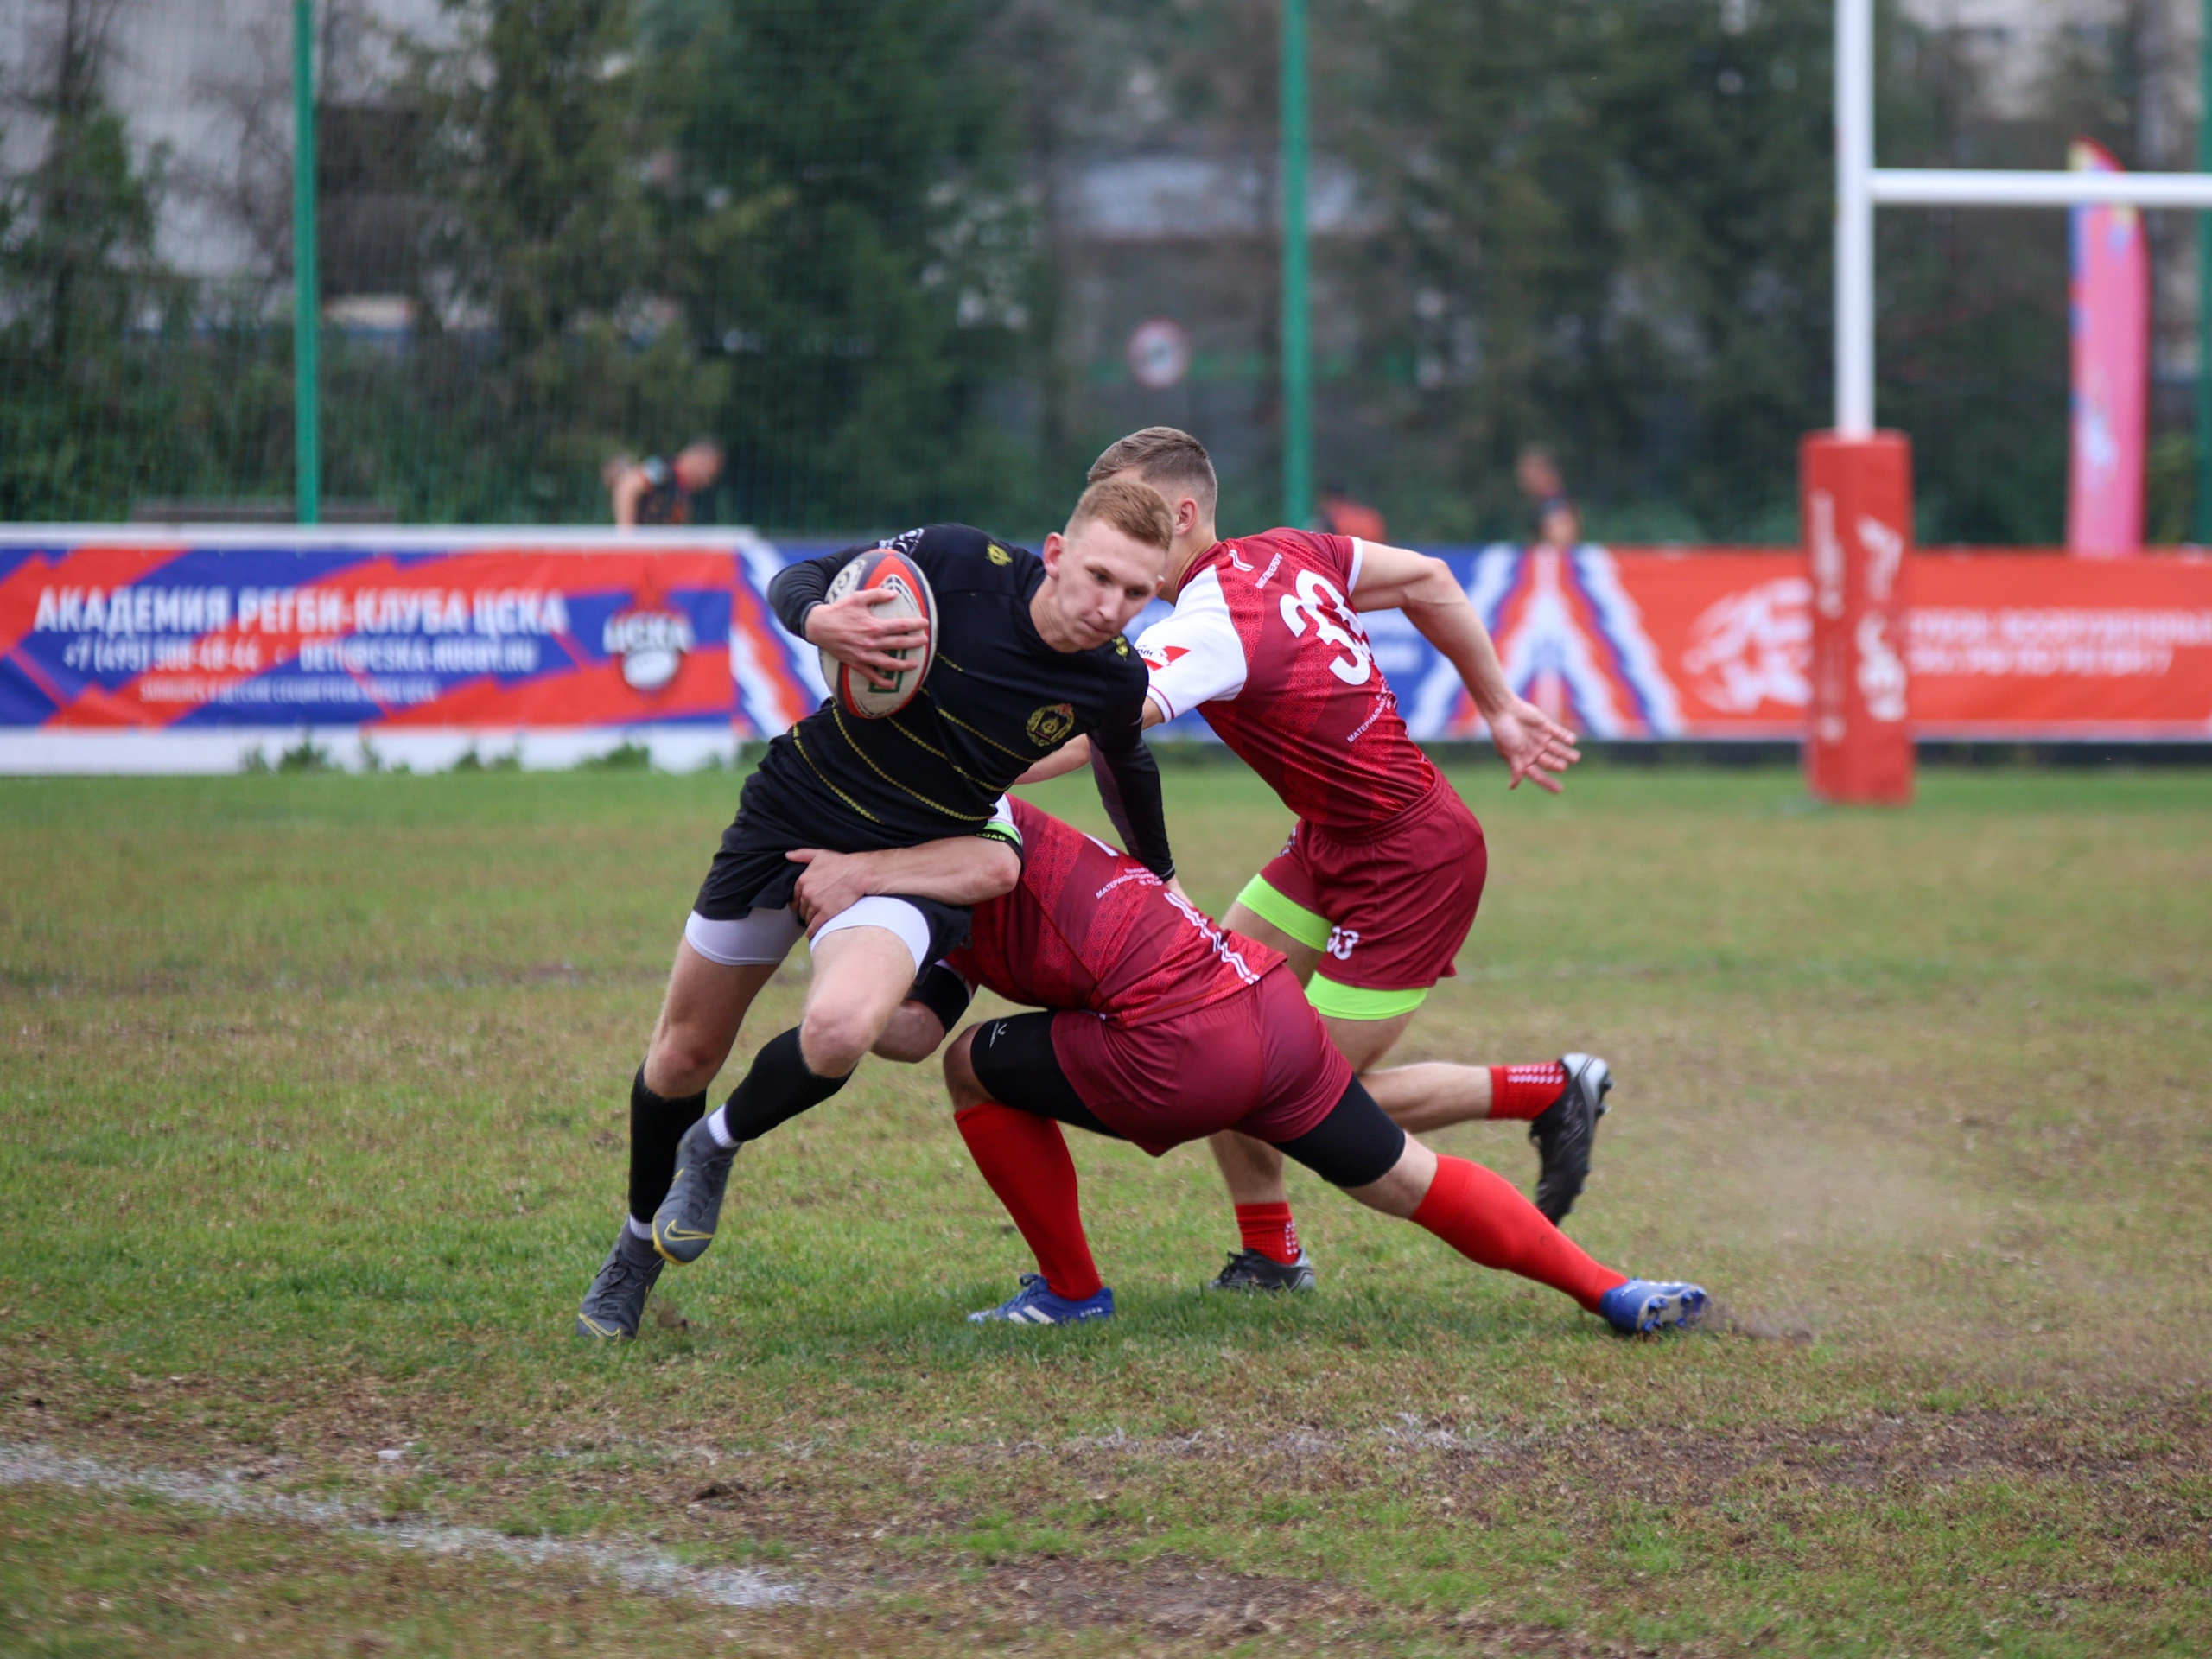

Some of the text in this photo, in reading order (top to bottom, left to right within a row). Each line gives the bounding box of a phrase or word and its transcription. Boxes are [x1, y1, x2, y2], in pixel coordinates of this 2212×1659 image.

[35, 586, 569, 641] АКАДЕМИЯ РЕГБИ-КЛУБА ЦСКА
